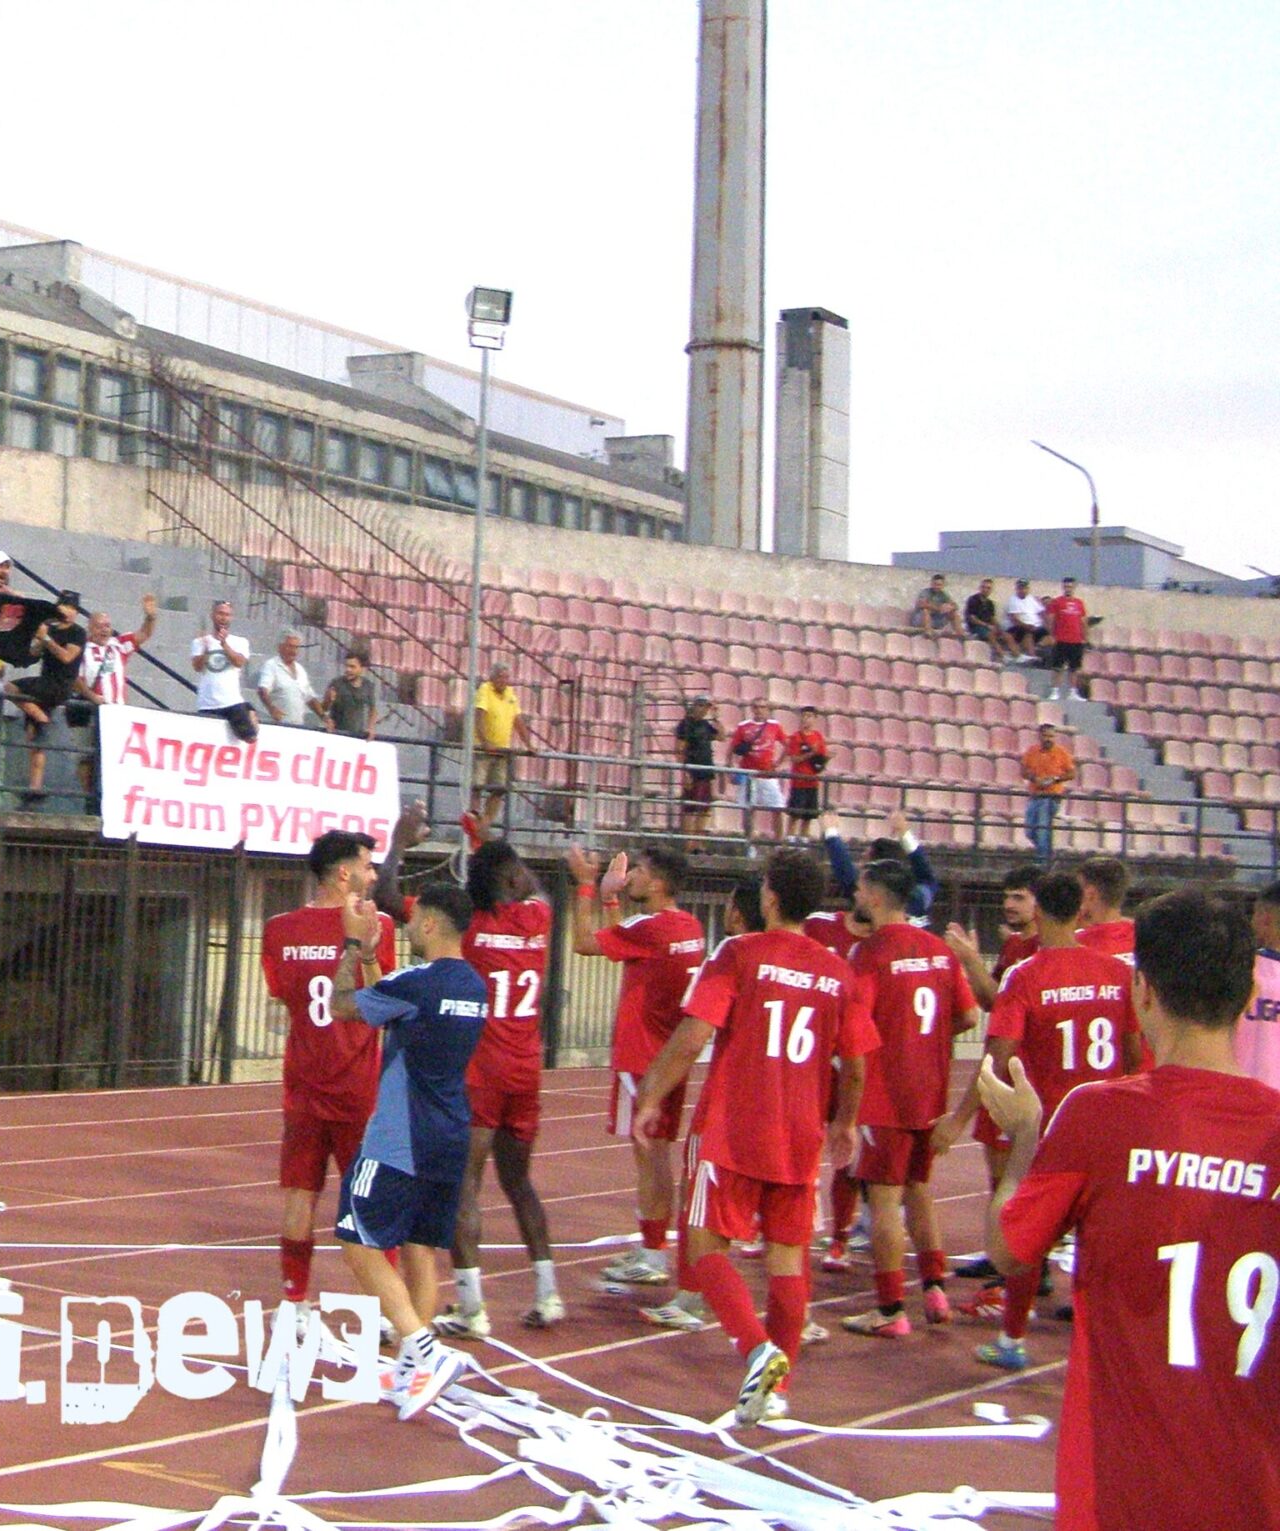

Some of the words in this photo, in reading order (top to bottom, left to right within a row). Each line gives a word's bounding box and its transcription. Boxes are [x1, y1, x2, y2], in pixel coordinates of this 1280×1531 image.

[119, 722, 281, 787] Angels
[290, 746, 379, 796] club
[123, 785, 226, 833] from
[283, 945, 338, 961] PYRGOS
[308, 975, 334, 1028] 8
[489, 969, 541, 1019] 12
[913, 986, 937, 1035] 9
[1041, 984, 1095, 1006] PYRGOS
[763, 1000, 815, 1064] 16
[1056, 1016, 1115, 1071] 18
[1127, 1148, 1266, 1198] PYRGOS
[1157, 1241, 1280, 1378] 19
